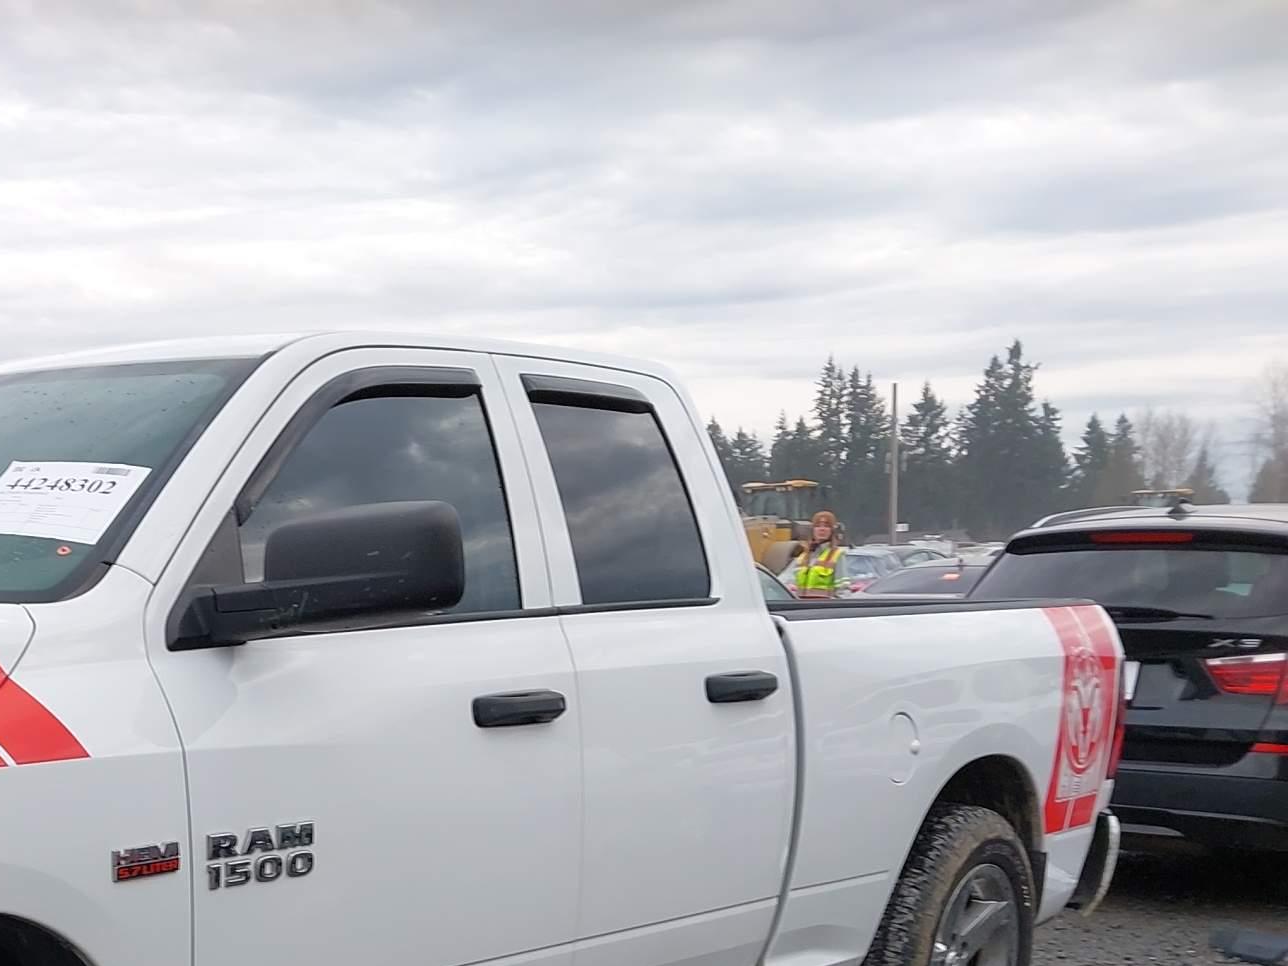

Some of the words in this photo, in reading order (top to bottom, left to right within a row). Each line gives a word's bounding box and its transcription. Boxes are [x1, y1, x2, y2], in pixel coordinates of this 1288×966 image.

[6, 477, 117, 495] 44248302
[1207, 638, 1263, 648] X3
[206, 820, 314, 860] RAM
[207, 850, 314, 891] 1500
